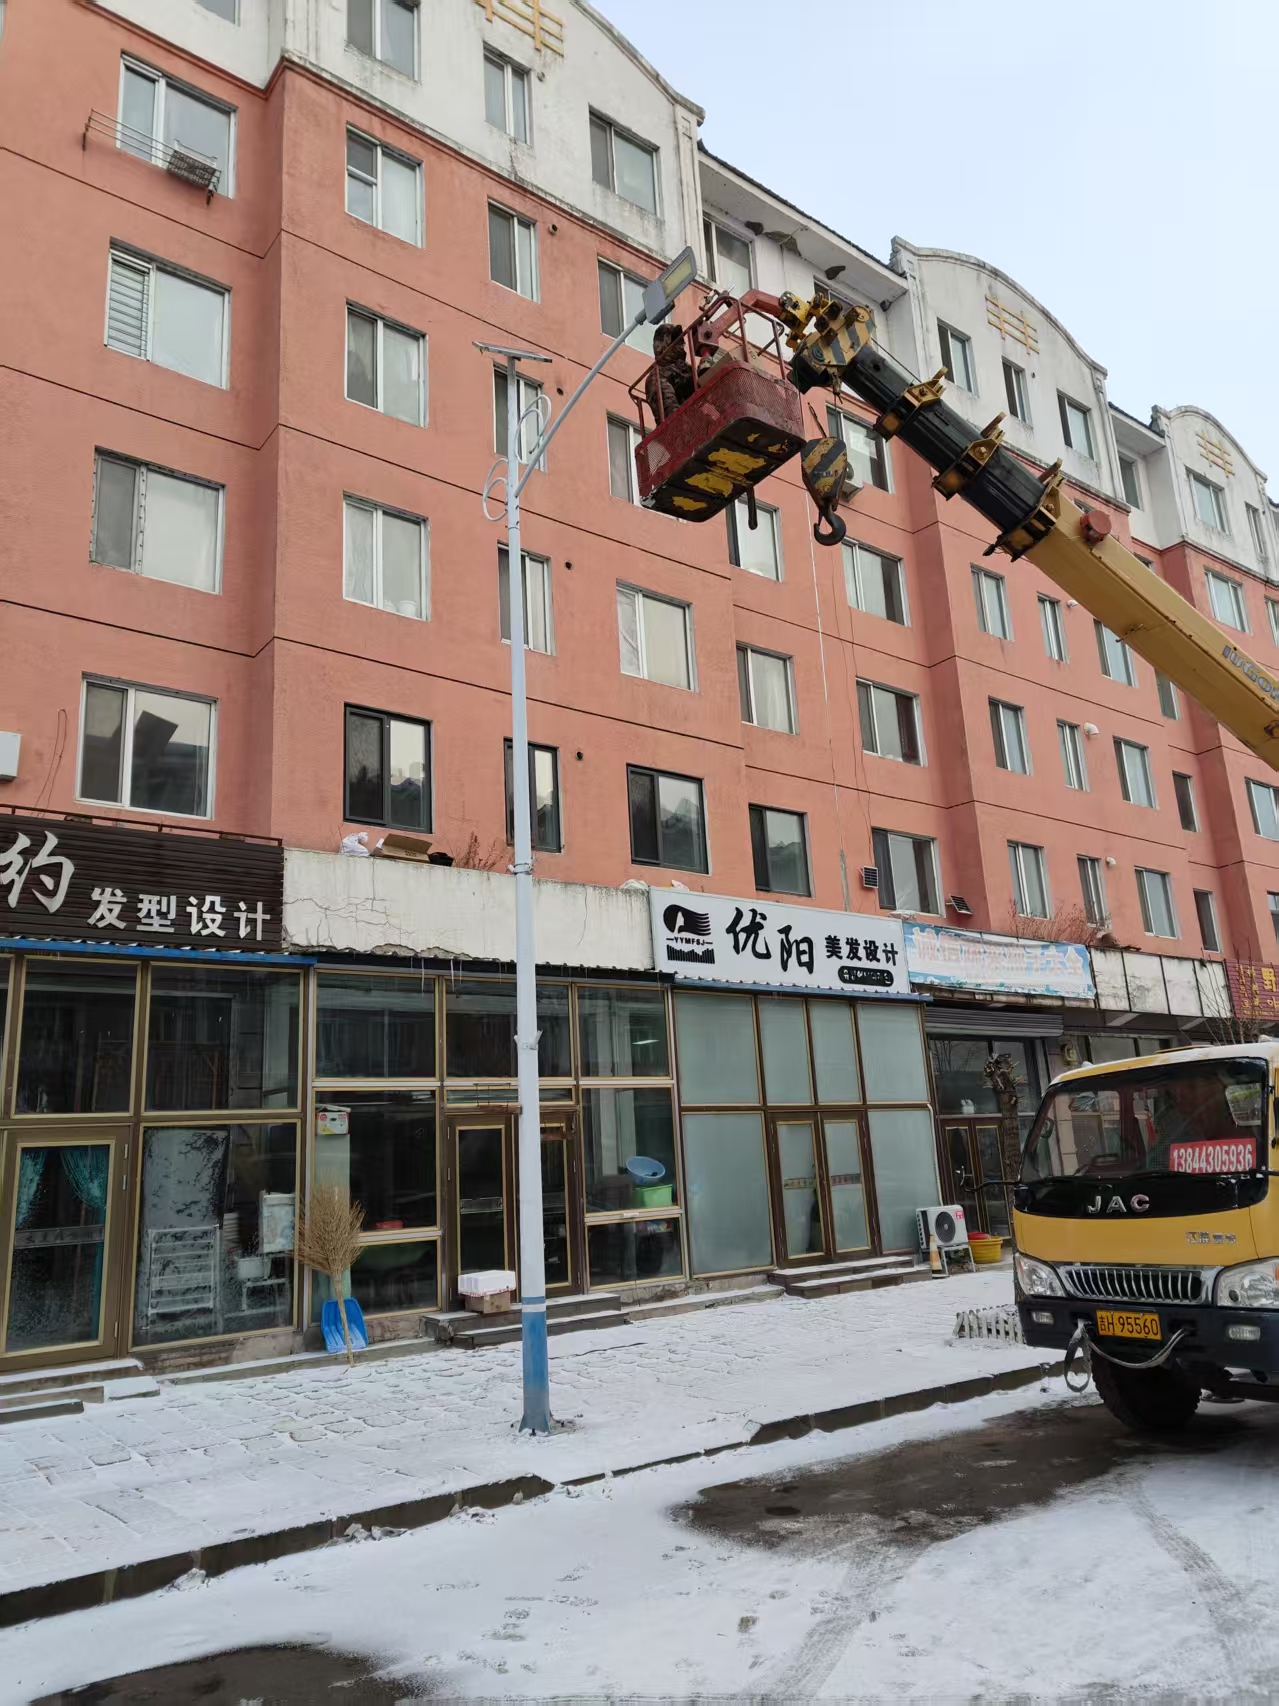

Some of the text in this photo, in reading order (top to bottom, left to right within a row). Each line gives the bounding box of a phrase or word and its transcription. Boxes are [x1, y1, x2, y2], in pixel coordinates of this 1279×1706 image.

[0, 831, 271, 941] 约 发型设计
[674, 936, 706, 946] YYMFSJ
[725, 907, 815, 975] 优阳
[825, 934, 899, 966] 美发设计
[1173, 1144, 1253, 1173] 13844305936
[1087, 1194, 1150, 1213] JAC
